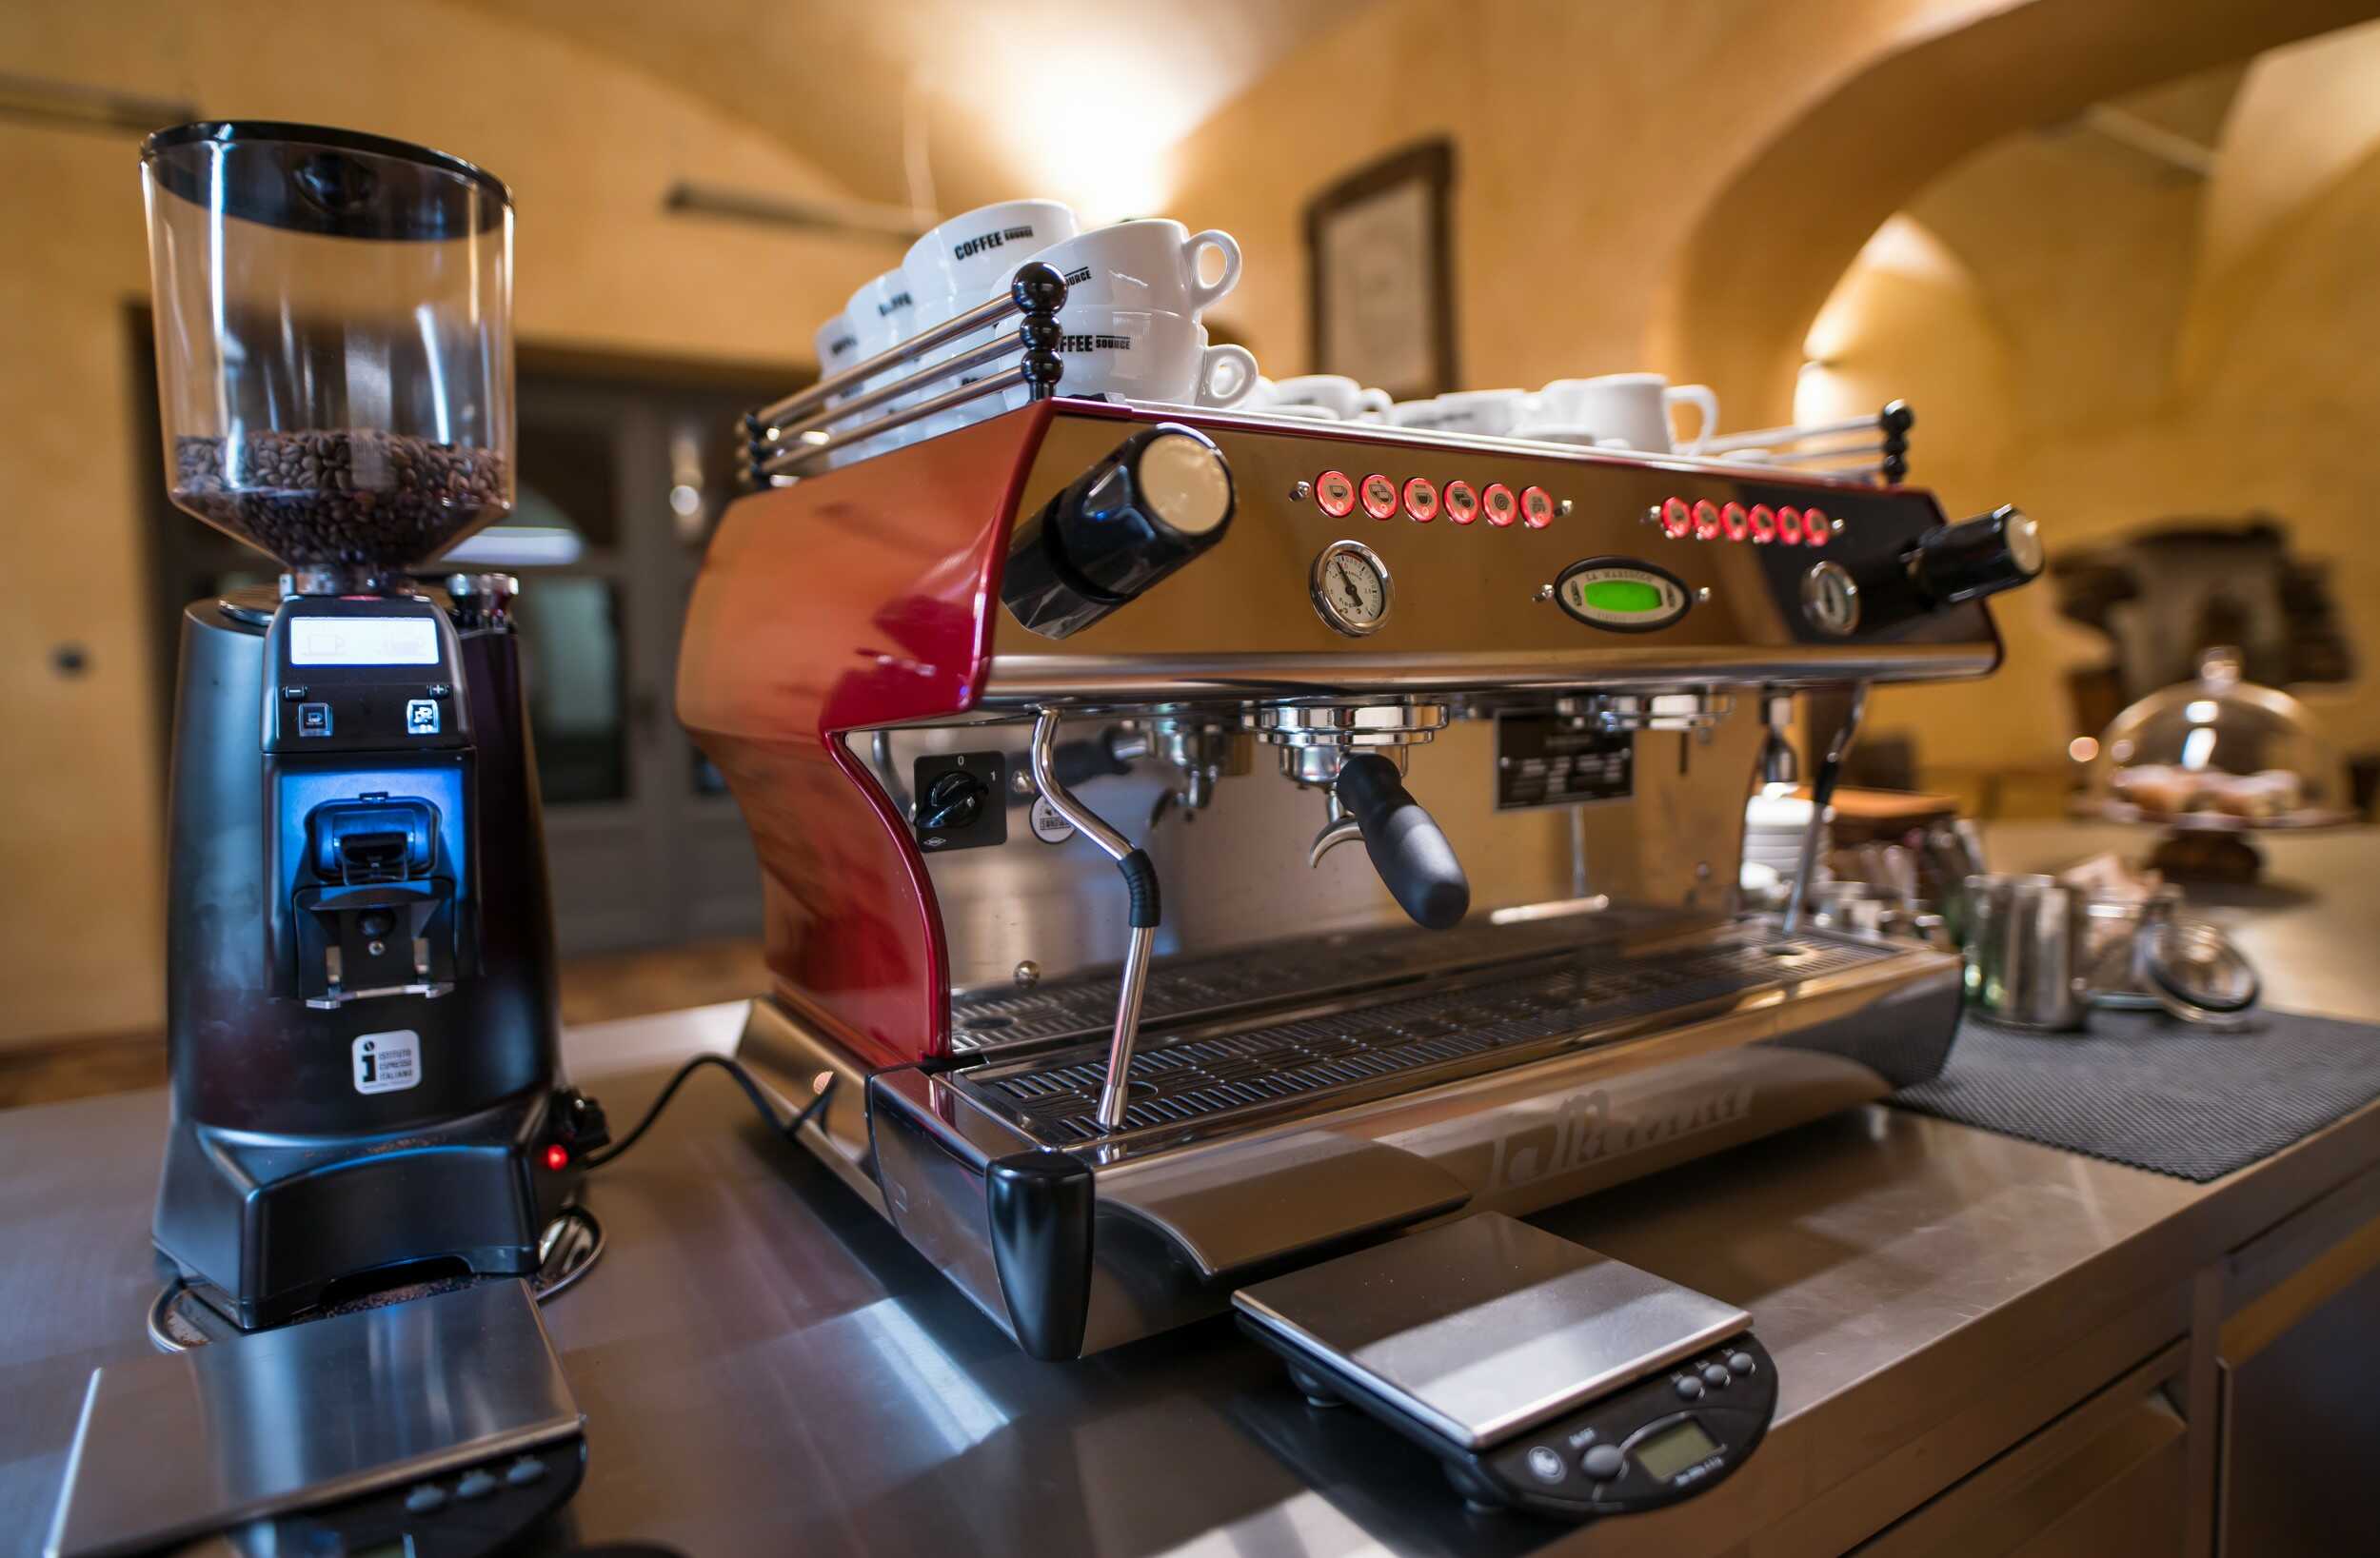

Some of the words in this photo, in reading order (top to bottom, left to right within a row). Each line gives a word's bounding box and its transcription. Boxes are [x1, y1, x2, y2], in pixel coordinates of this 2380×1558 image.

[954, 231, 1003, 260] COFFEE
[1064, 270, 1092, 287] OURCE
[1057, 335, 1093, 352] FFEE
[1095, 339, 1130, 349] SOURCE
[958, 756, 964, 766] 0
[990, 770, 997, 781] 1
